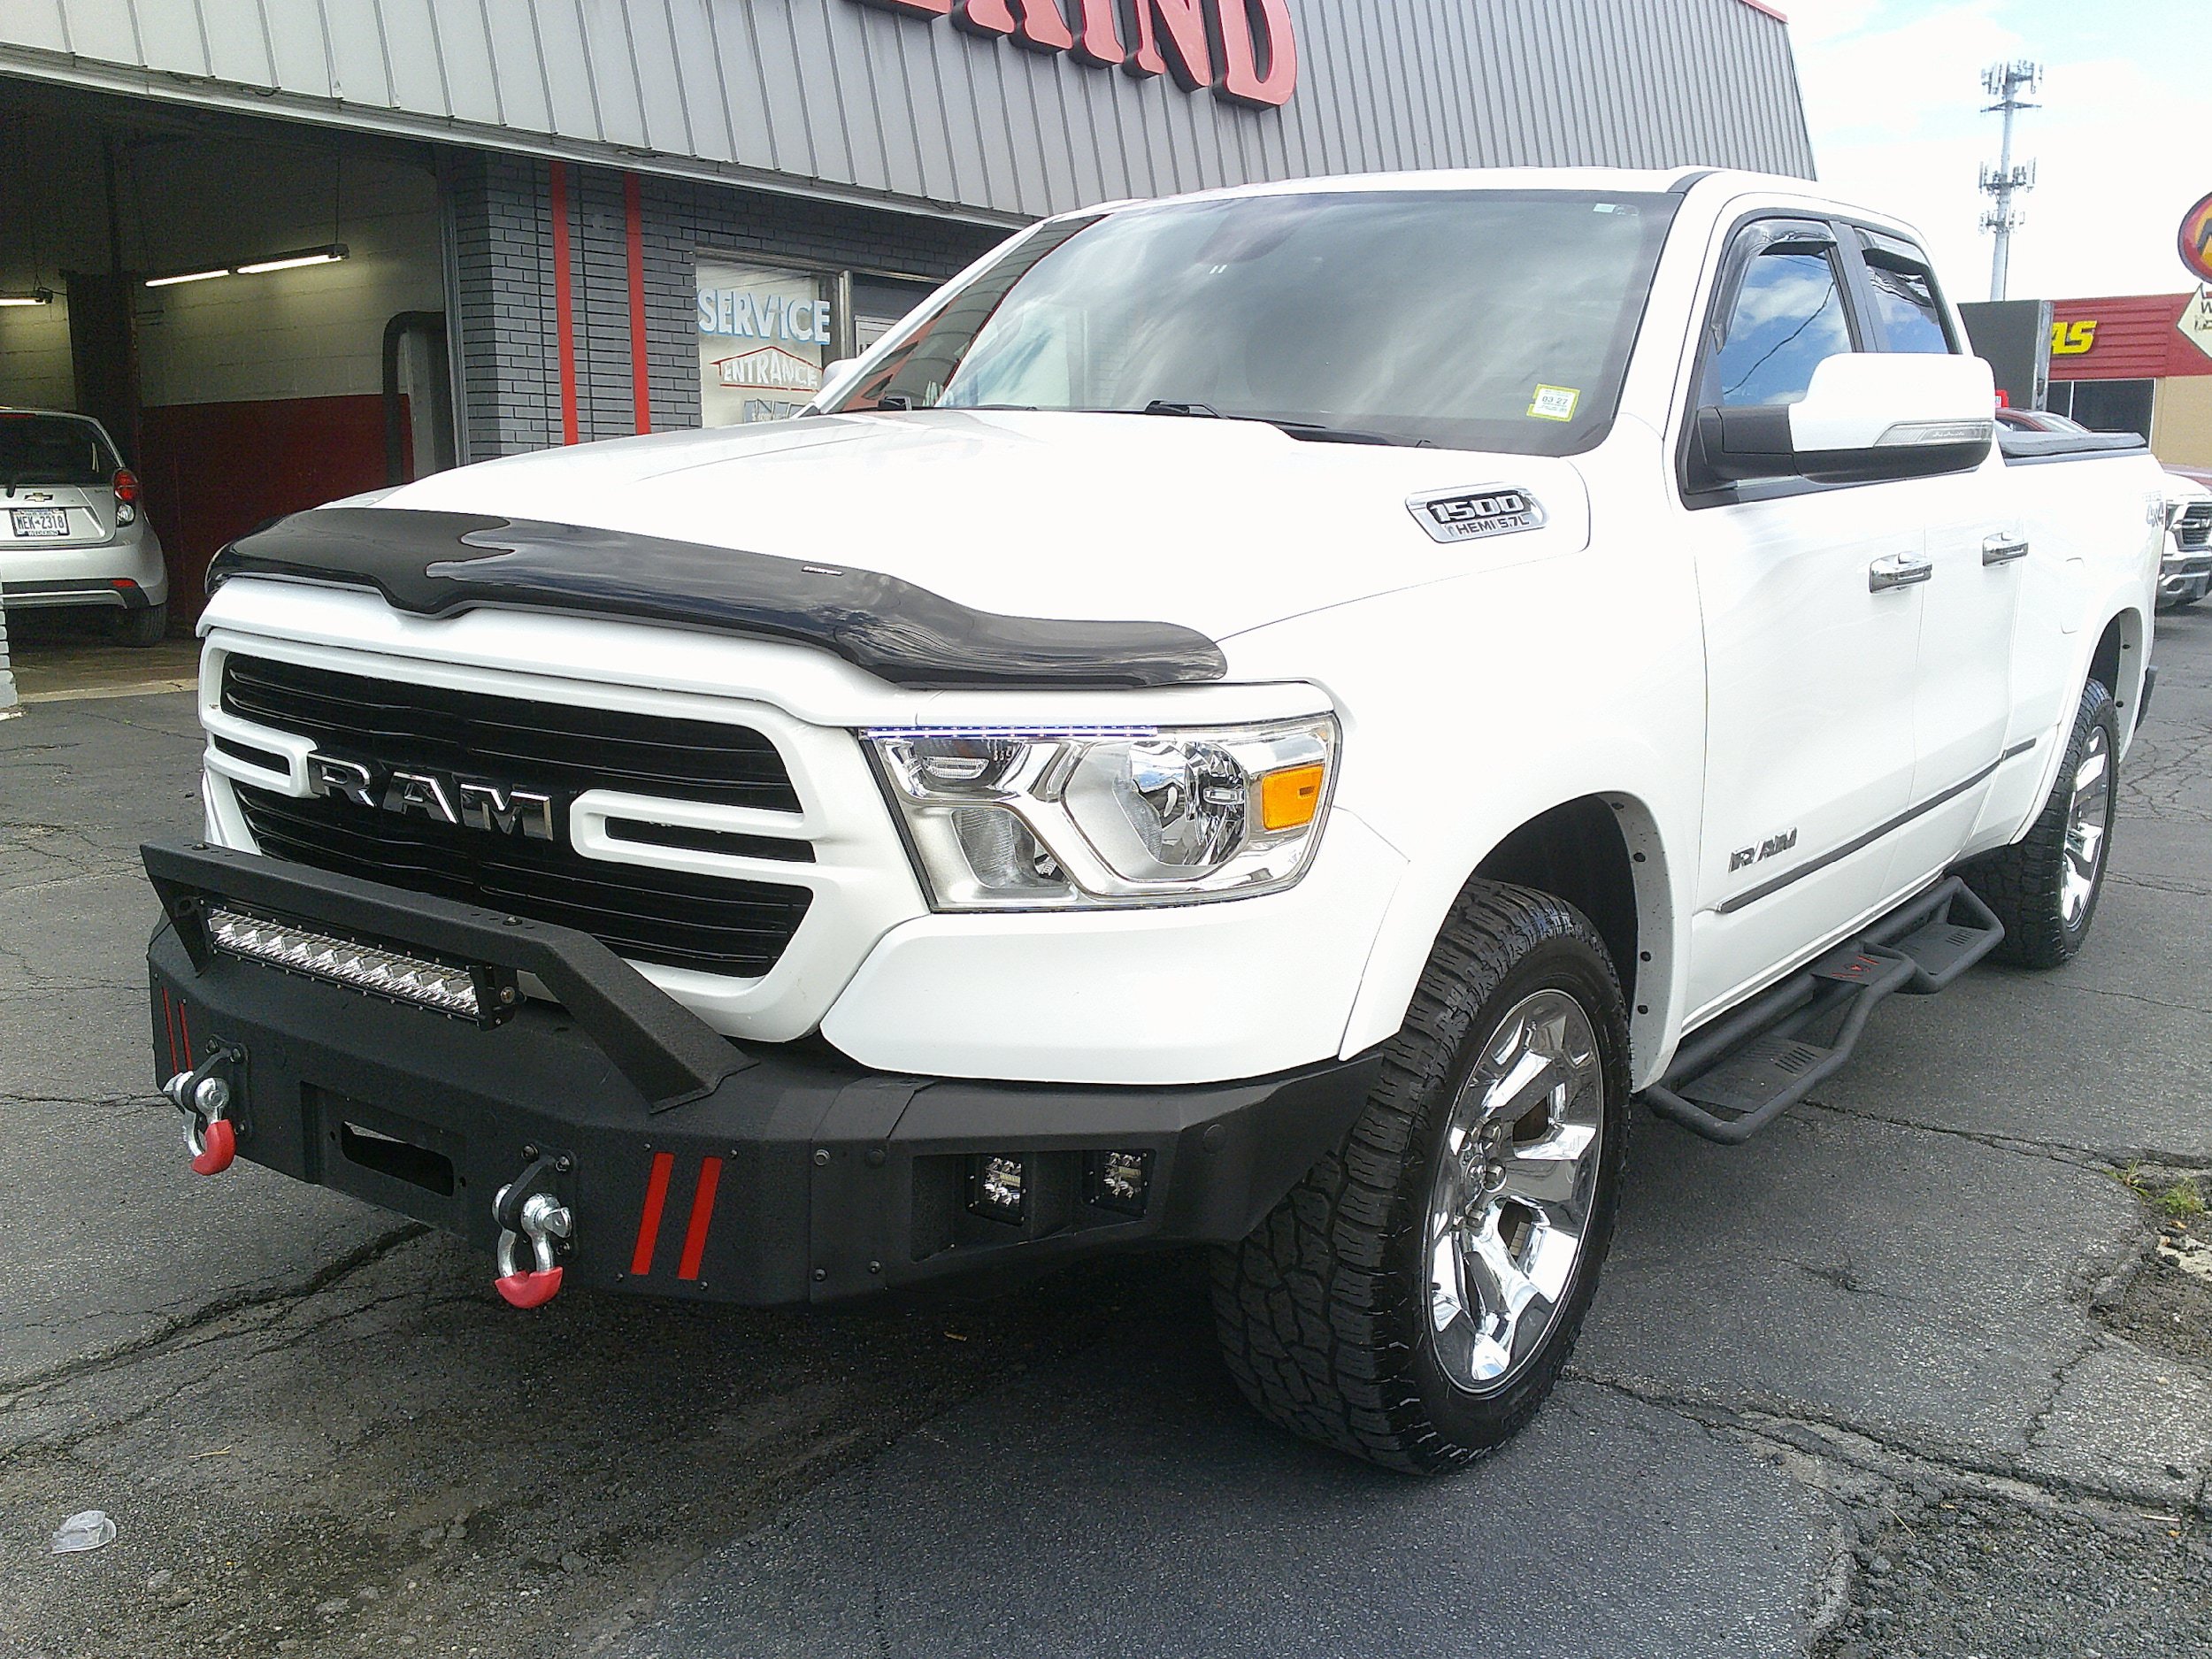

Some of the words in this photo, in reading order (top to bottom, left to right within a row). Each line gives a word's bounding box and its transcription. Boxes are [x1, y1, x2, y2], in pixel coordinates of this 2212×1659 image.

[697, 288, 831, 345] SERVICE
[723, 350, 818, 388] ENTRANCE
[1430, 493, 1524, 522] 1500
[1455, 520, 1496, 535] HEMI
[1499, 516, 1530, 529] 5.7L
[307, 752, 554, 841] RAM
[1728, 826, 1798, 873] RAM
